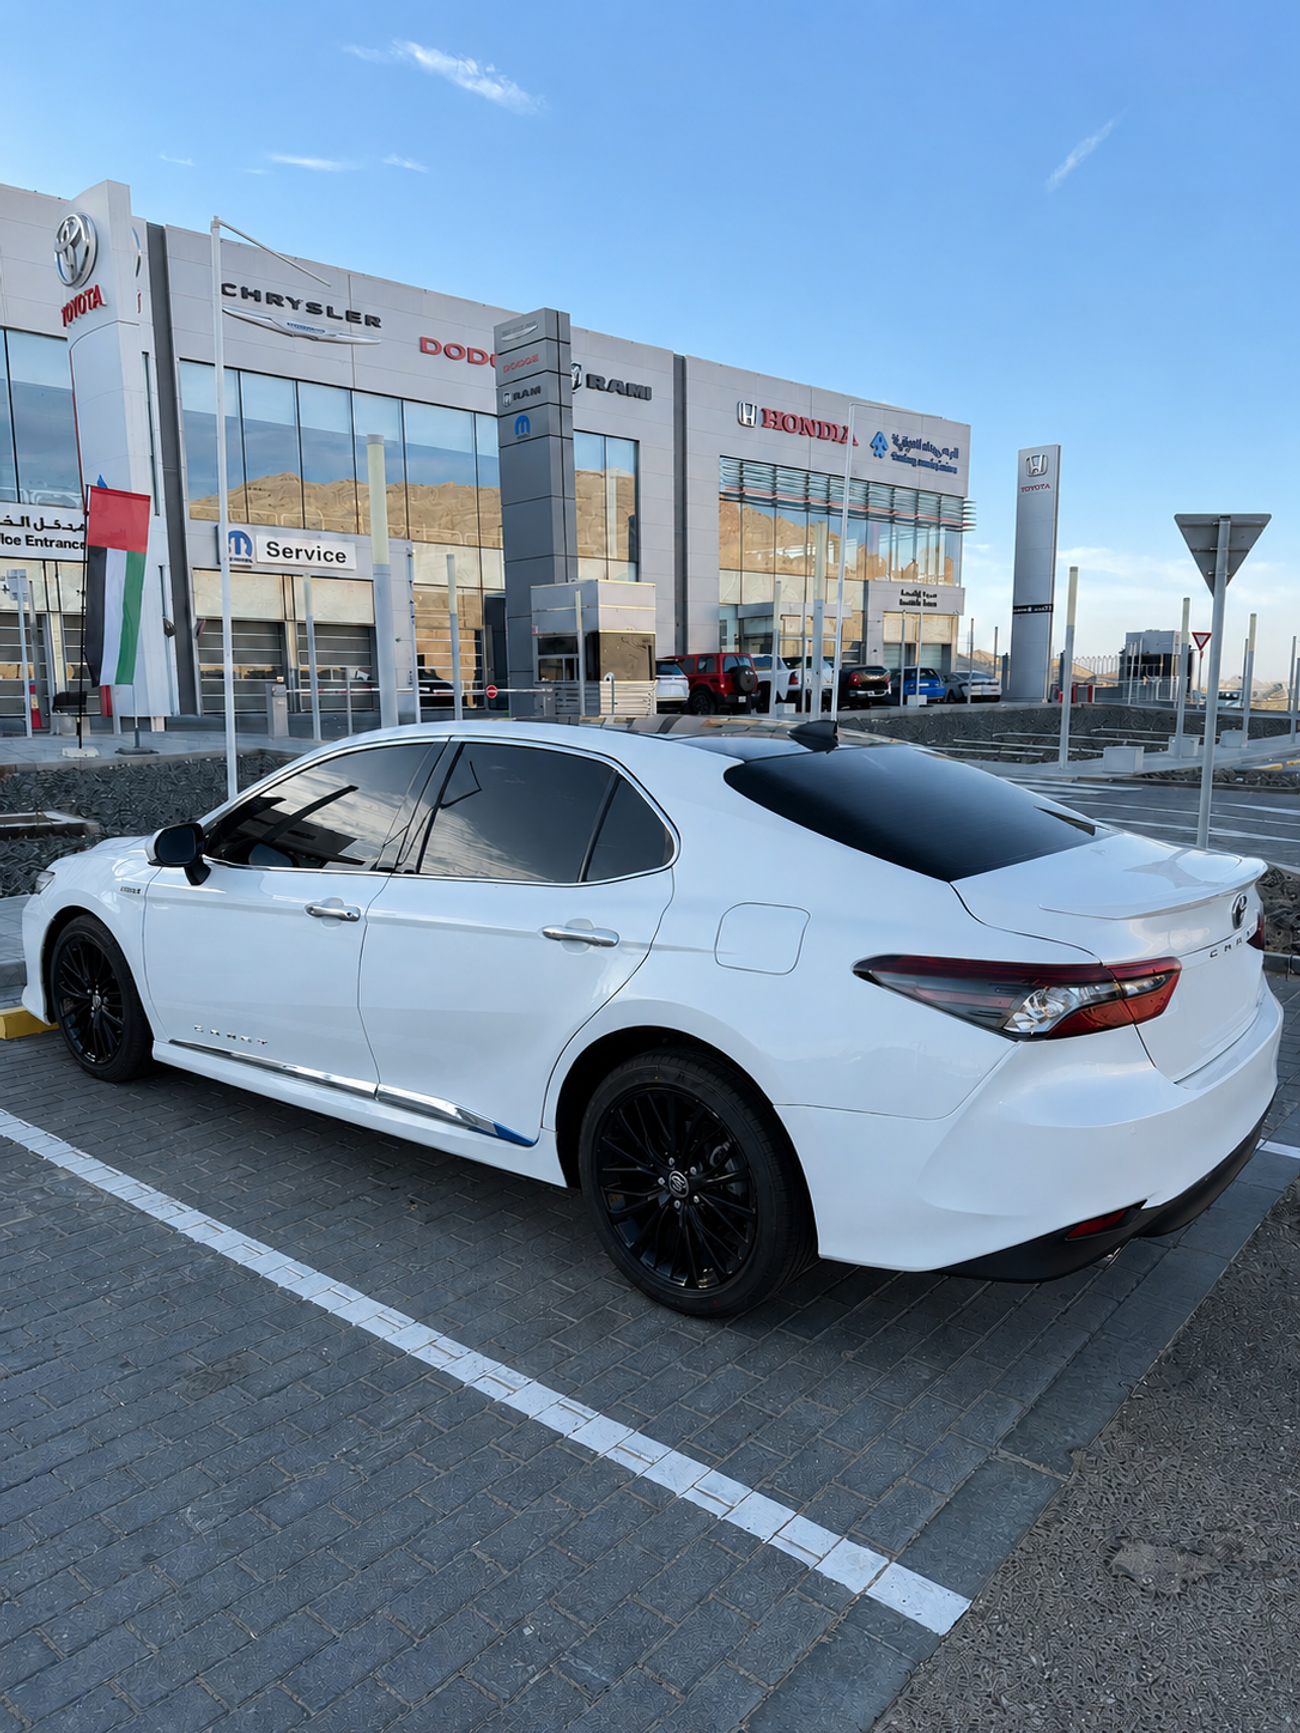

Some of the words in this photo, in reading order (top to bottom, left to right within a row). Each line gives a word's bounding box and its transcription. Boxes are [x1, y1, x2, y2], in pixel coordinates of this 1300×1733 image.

[61, 284, 104, 328] TOYOTA
[221, 282, 382, 329] CHRYSLER
[419, 336, 498, 369] DOD
[513, 386, 542, 401] RAM
[1021, 483, 1051, 492] TOYOTA
[266, 541, 347, 564] Service
